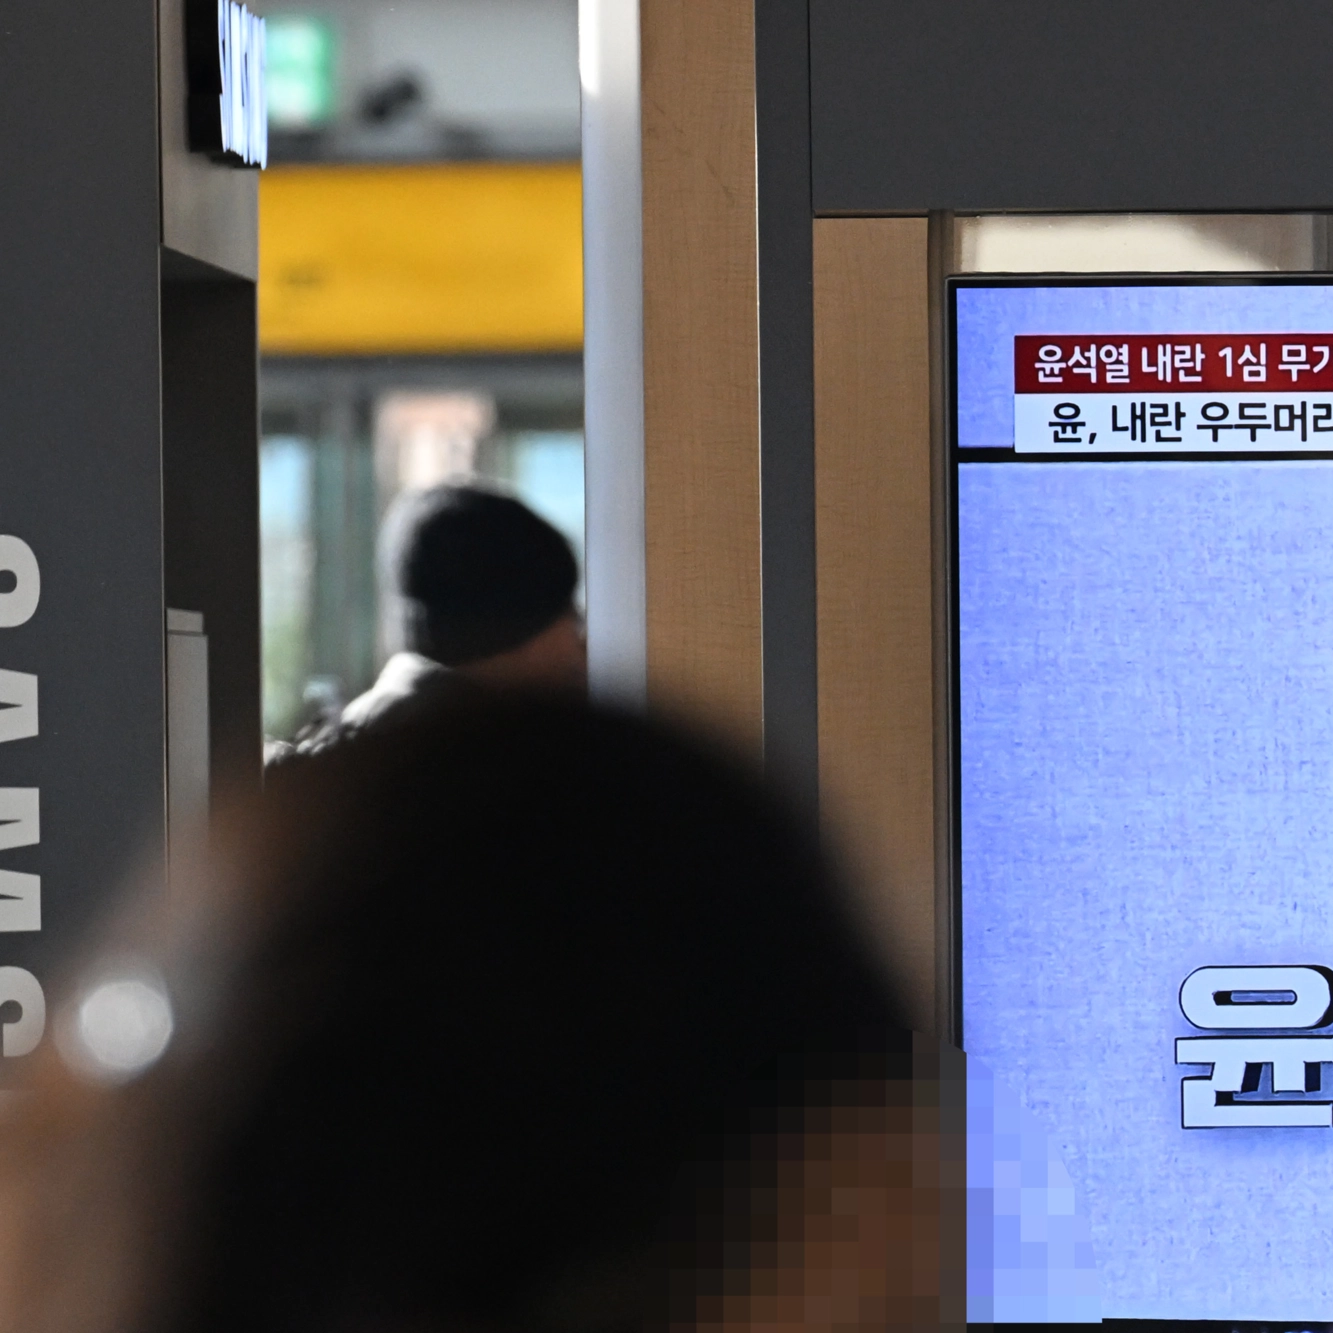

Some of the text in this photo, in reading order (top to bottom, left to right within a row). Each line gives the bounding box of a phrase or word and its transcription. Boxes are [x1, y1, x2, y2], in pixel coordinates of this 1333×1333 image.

[1034, 343, 1130, 384] 윤석열
[1141, 342, 1204, 383] 내란
[1219, 341, 1267, 382] 1심
[1048, 402, 1097, 445] 윤,
[1111, 401, 1186, 442] 내란
